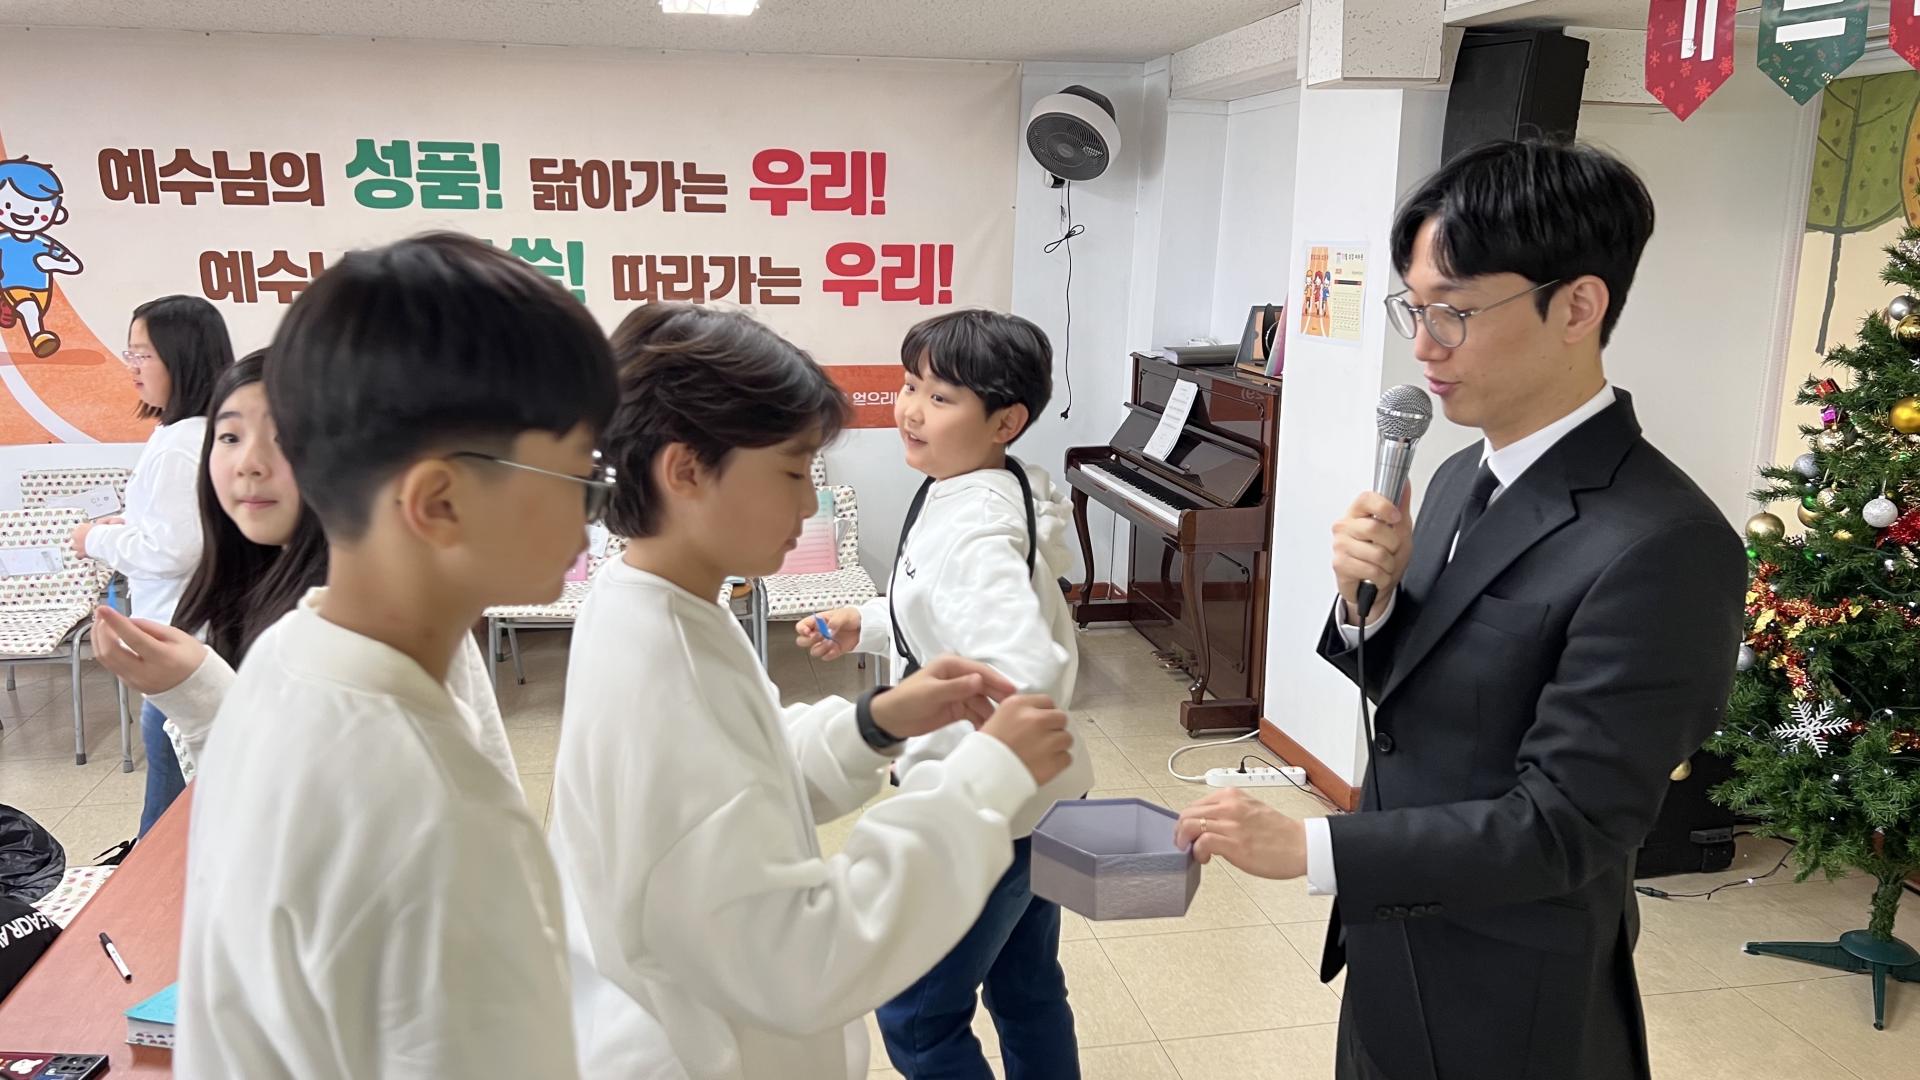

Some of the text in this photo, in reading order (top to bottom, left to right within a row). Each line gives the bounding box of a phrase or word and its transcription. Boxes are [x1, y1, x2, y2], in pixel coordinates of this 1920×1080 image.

[98, 139, 887, 216] 예수님의 성품! 닮아가는 우리!
[612, 255, 802, 304] 따라가는
[822, 241, 954, 306] 우리!
